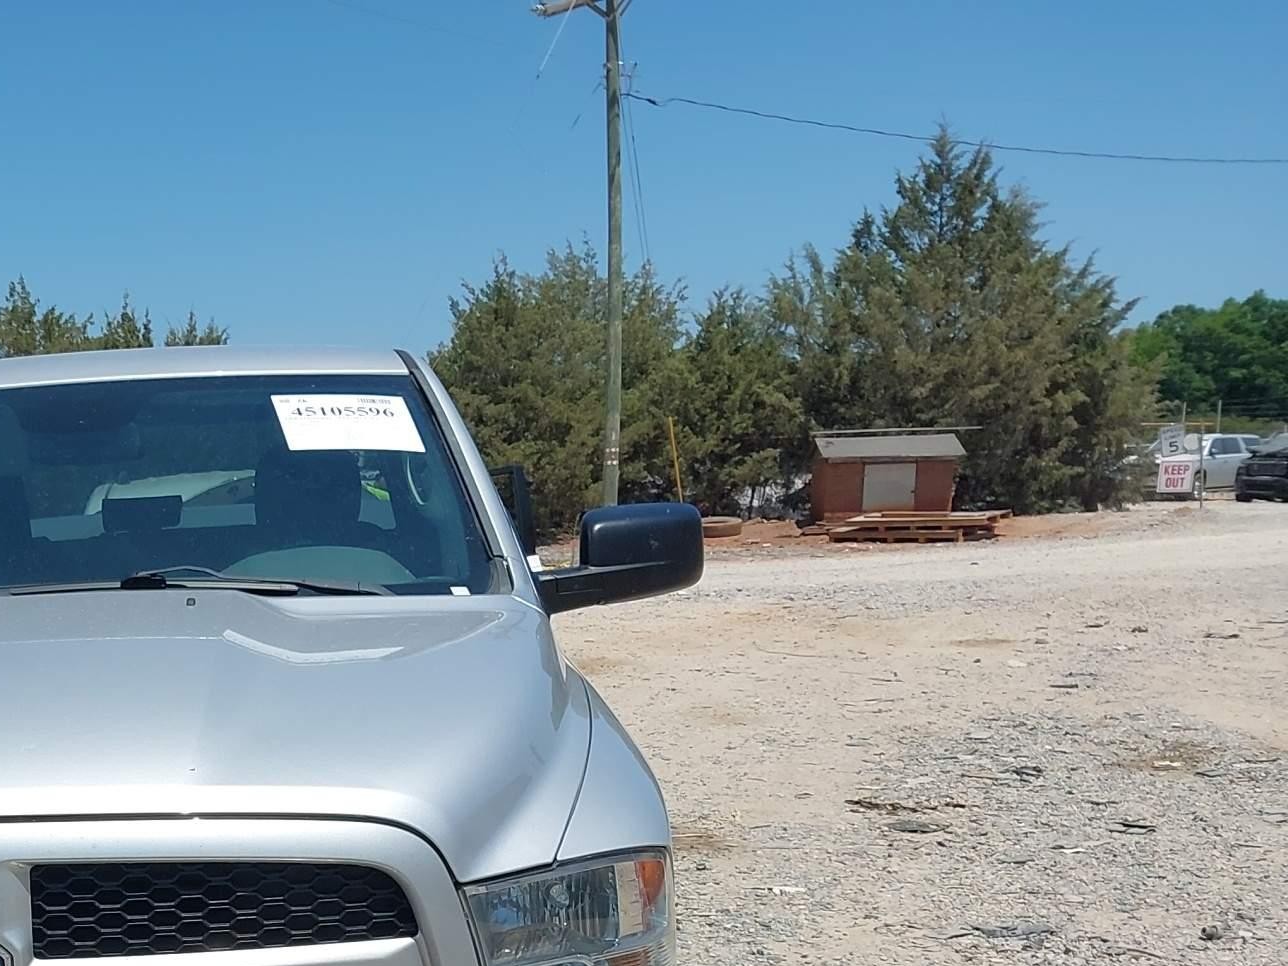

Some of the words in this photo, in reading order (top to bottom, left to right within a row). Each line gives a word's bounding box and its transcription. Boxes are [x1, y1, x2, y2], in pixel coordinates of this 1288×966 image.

[291, 406, 395, 418] 45105596
[1168, 440, 1180, 453] 5
[1163, 463, 1191, 476] KEEP
[1164, 477, 1185, 489] OUT
